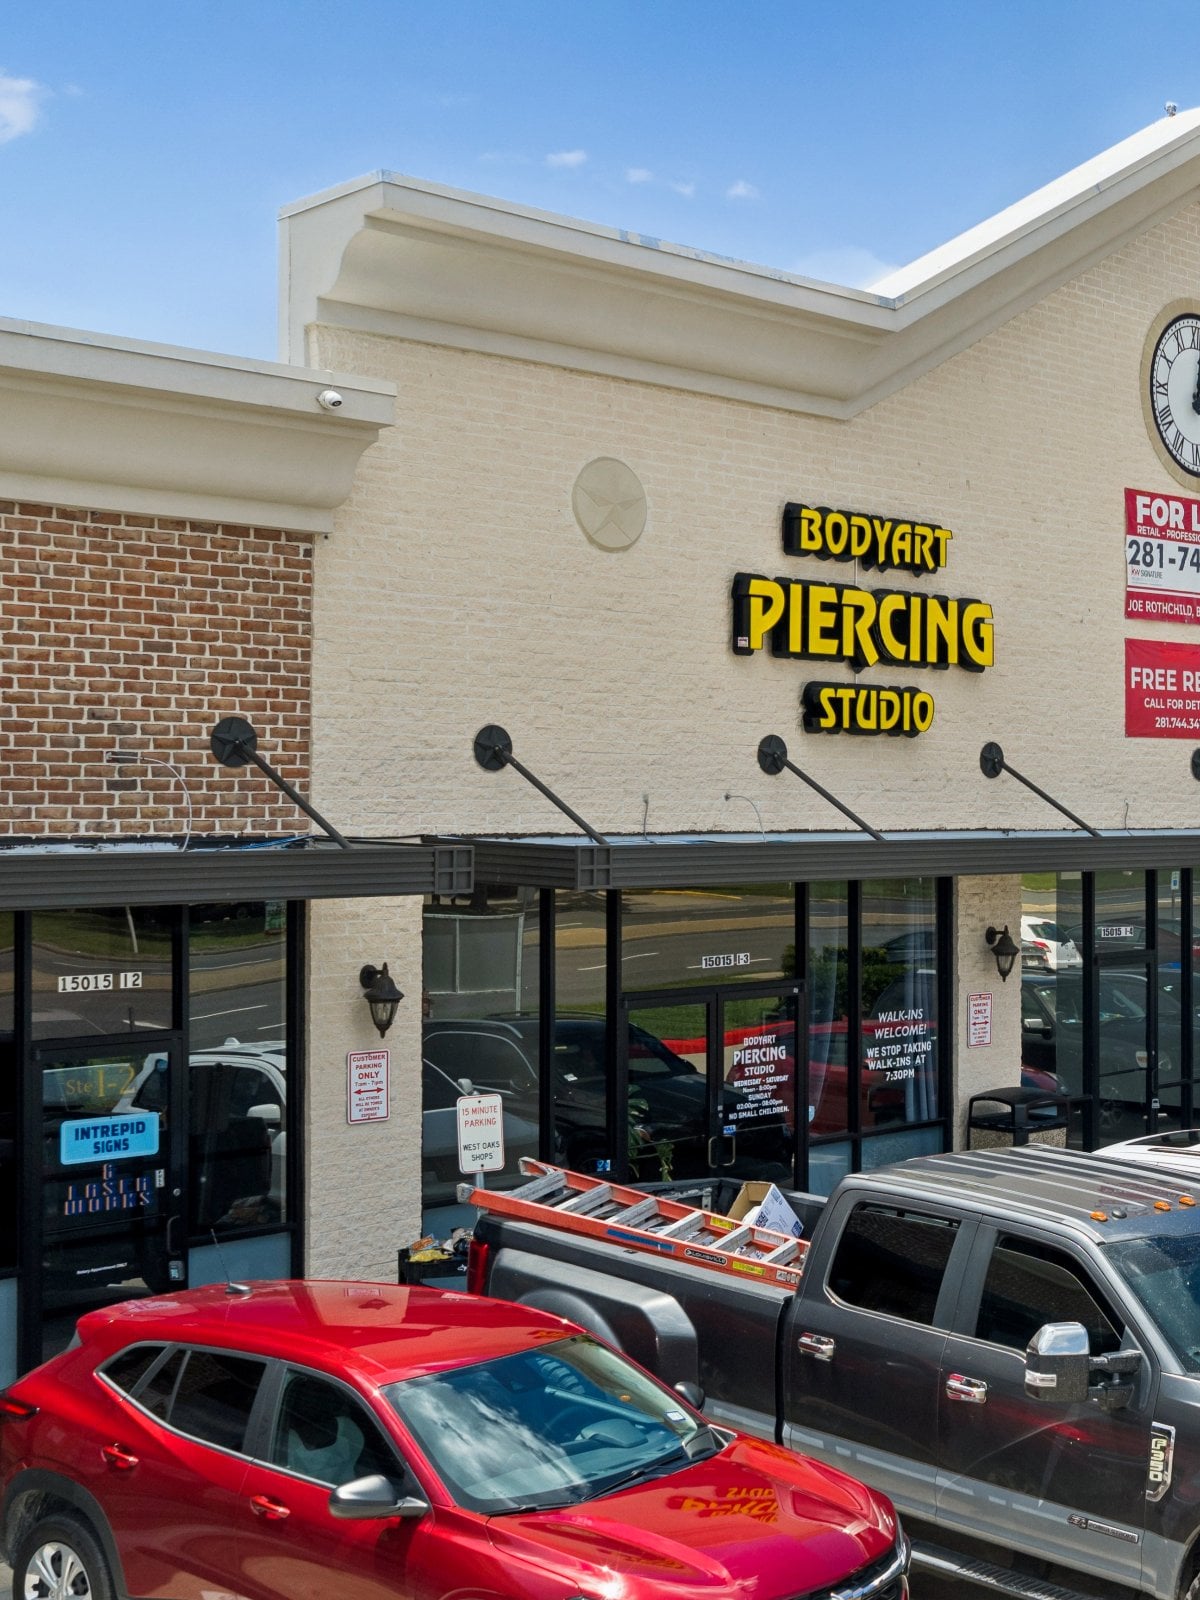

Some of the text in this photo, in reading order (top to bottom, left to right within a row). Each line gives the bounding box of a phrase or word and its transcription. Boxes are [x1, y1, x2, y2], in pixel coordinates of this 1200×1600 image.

[1136, 495, 1184, 530] FOR
[1137, 525, 1160, 537] RETAIL
[800, 508, 953, 570] BODYART
[1128, 600, 1143, 611] JOE
[1146, 602, 1194, 618] ROTHCHILD,
[748, 579, 994, 667] PIERCING
[1131, 667, 1177, 691] FREE
[819, 687, 934, 732] STUDIO
[1144, 698, 1165, 709] CALL
[1166, 699, 1183, 710] FOR
[1103, 927, 1121, 936] 15015
[703, 955, 732, 967] 15015
[61, 975, 112, 991] 15015
[878, 1009, 923, 1023] WALK-INS
[875, 1024, 927, 1039] WELCOME!
[743, 1035, 776, 1046] BODYART
[733, 1045, 786, 1065] PIERCING
[867, 1041, 932, 1058] WE STOP TAKING
[353, 1054, 385, 1062] CUSTOMER
[868, 1054, 926, 1071] WALK-INS AT
[358, 1071, 379, 1079] ONLY
[744, 1064, 775, 1076] STUDIO
[885, 1068, 915, 1081] 7:30PM
[766, 1075, 789, 1083] SATURDAY
[66, 1080, 92, 1094] Ste
[748, 1092, 772, 1100] SUNDAY
[462, 1105, 498, 1116] 15 MINUTE
[738, 1109, 757, 1119] SMALL
[464, 1117, 497, 1128] PARKING
[74, 1121, 146, 1141] INTREPID
[93, 1138, 129, 1154] SIGNS
[463, 1141, 500, 1151] WEST OAKS
[471, 1152, 493, 1161] SHOPS
[1149, 1438, 1168, 1481] F350
